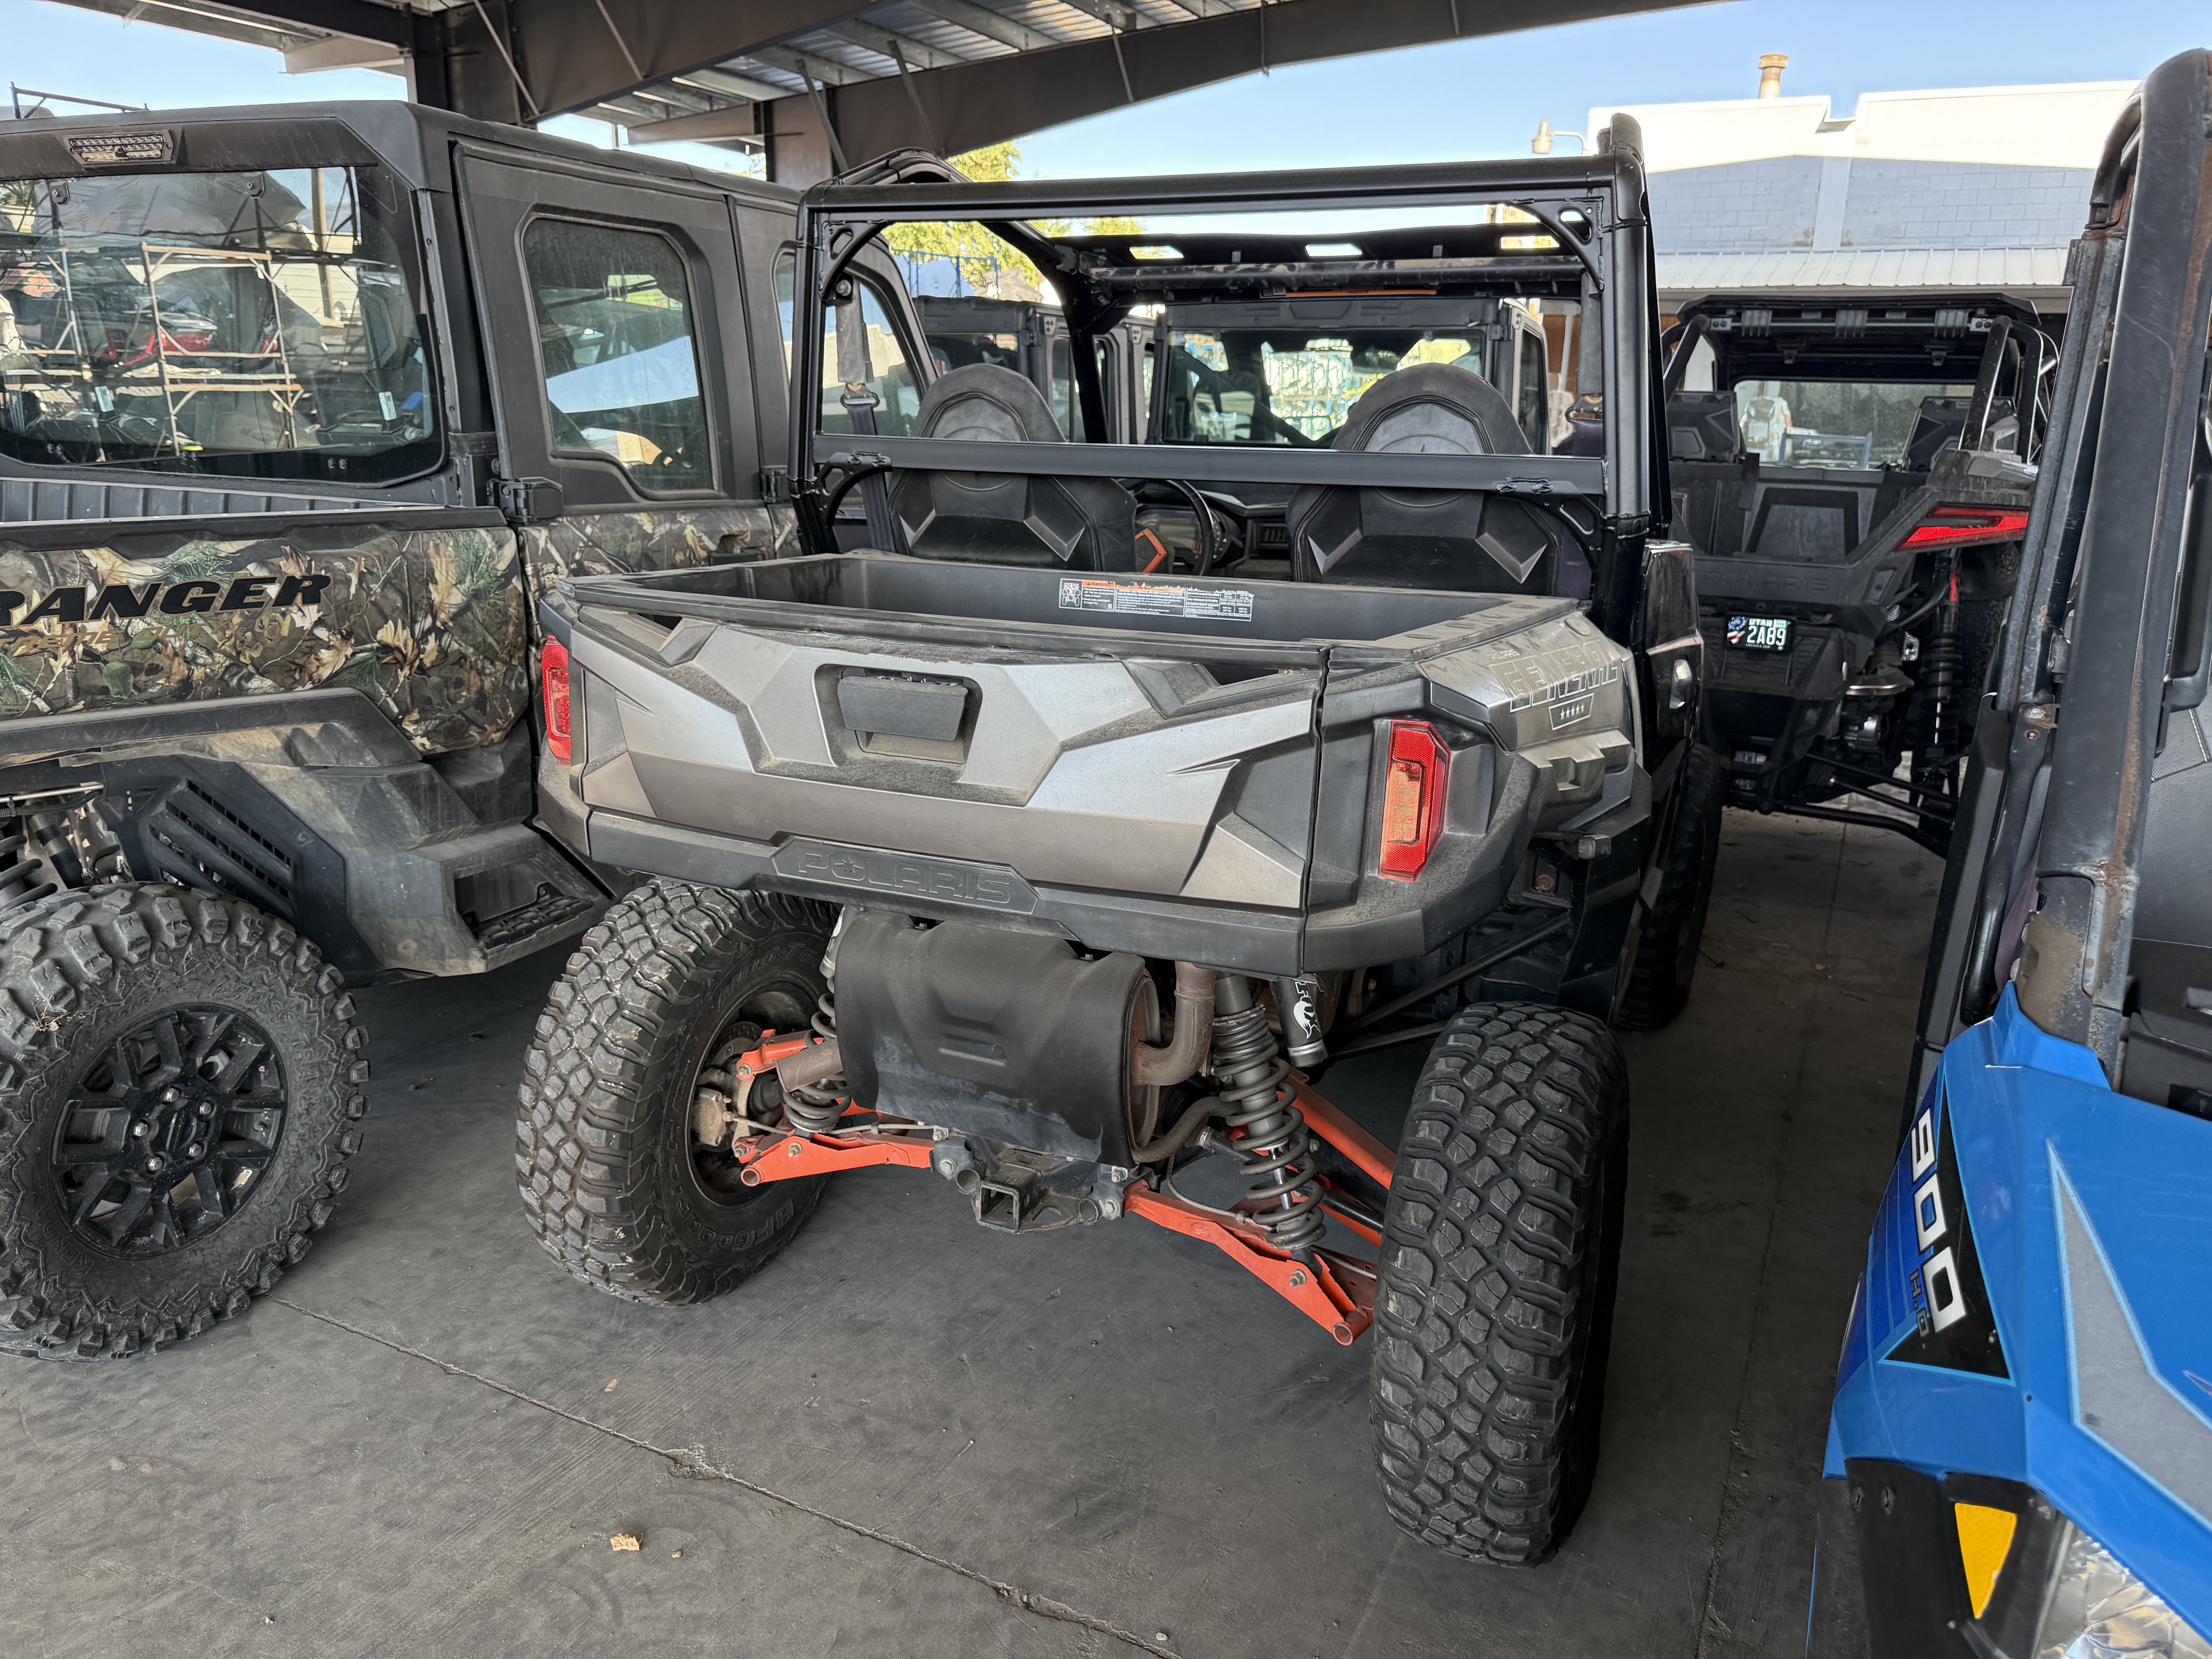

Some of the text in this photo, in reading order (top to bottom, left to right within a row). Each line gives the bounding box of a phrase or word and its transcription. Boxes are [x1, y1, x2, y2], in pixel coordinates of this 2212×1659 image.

[1747, 625, 1787, 646] 2A89
[1748, 618, 1773, 627] UTAH
[1489, 639, 1618, 713] GENERAL
[798, 847, 1010, 903] POLARIS
[1293, 981, 1321, 1037] FOX
[1911, 1107, 1966, 1333] 900
